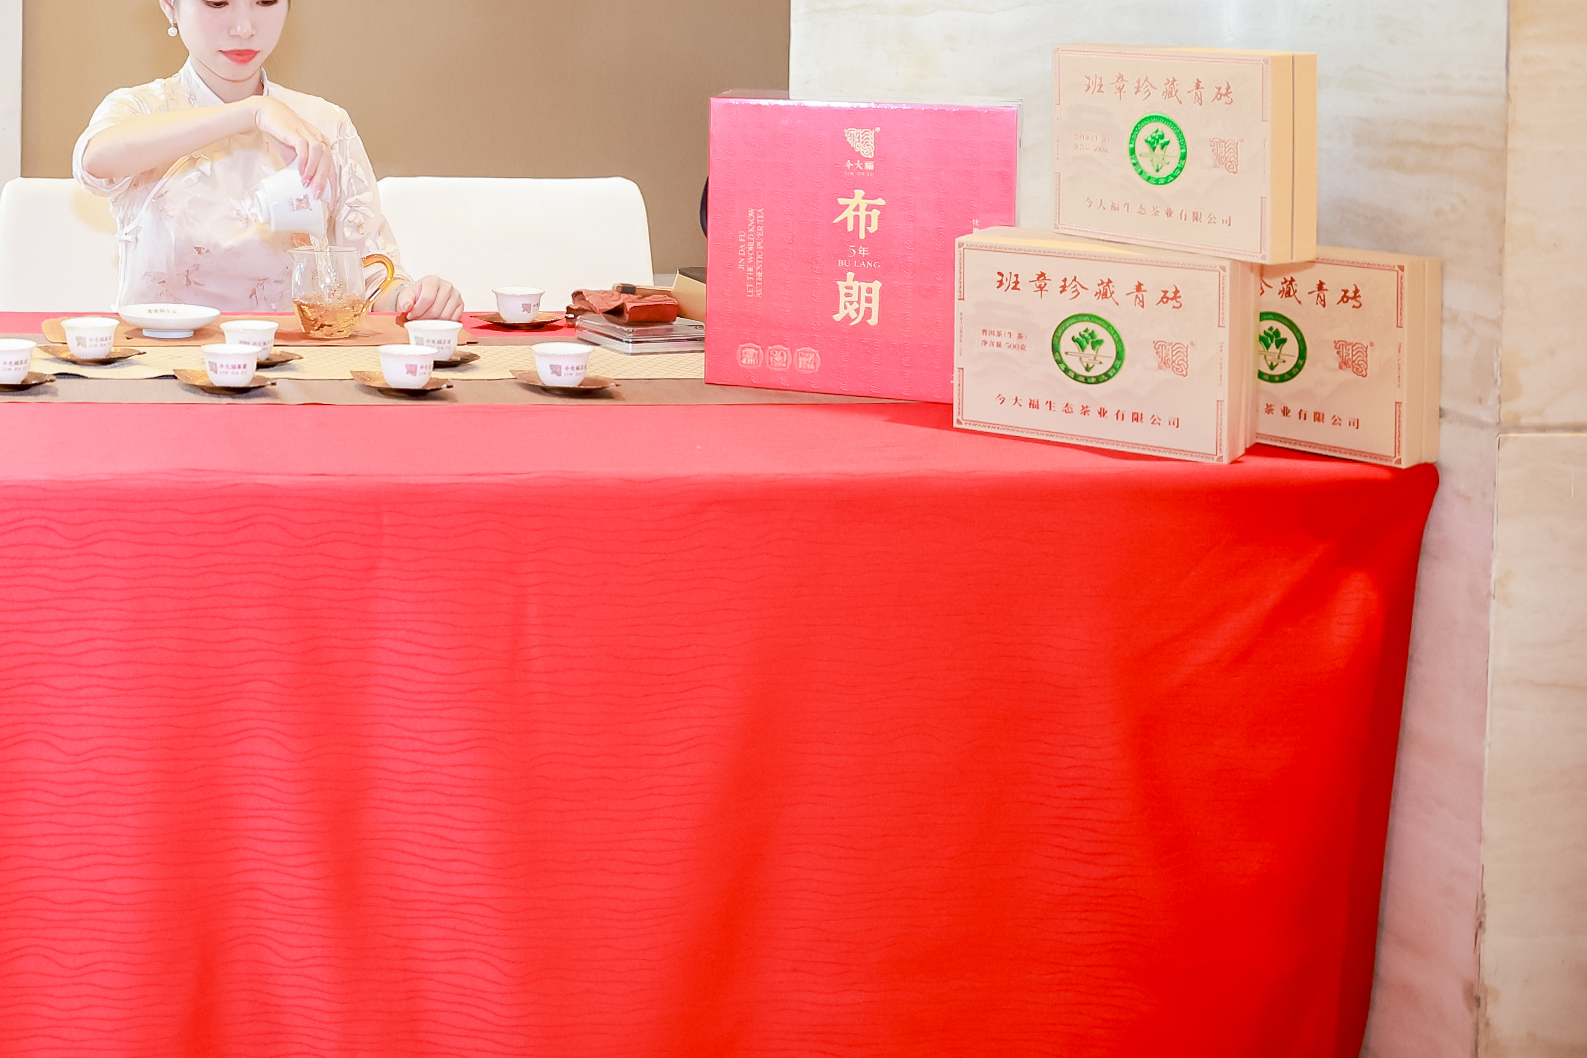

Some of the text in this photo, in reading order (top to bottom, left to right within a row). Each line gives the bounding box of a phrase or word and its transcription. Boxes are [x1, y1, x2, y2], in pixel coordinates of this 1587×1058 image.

[1084, 71, 1235, 108] 班章珍藏青砖
[844, 159, 875, 171] 今大福
[832, 189, 886, 240] 布
[1084, 195, 1234, 229] 今大福生态茶业有限公司
[838, 259, 881, 269] BU LANG
[848, 245, 870, 258] 5年
[832, 270, 881, 327] 朗
[995, 269, 1184, 311] 班章珍藏青砖
[994, 393, 1182, 430] 今大福生态茶业有限公司
